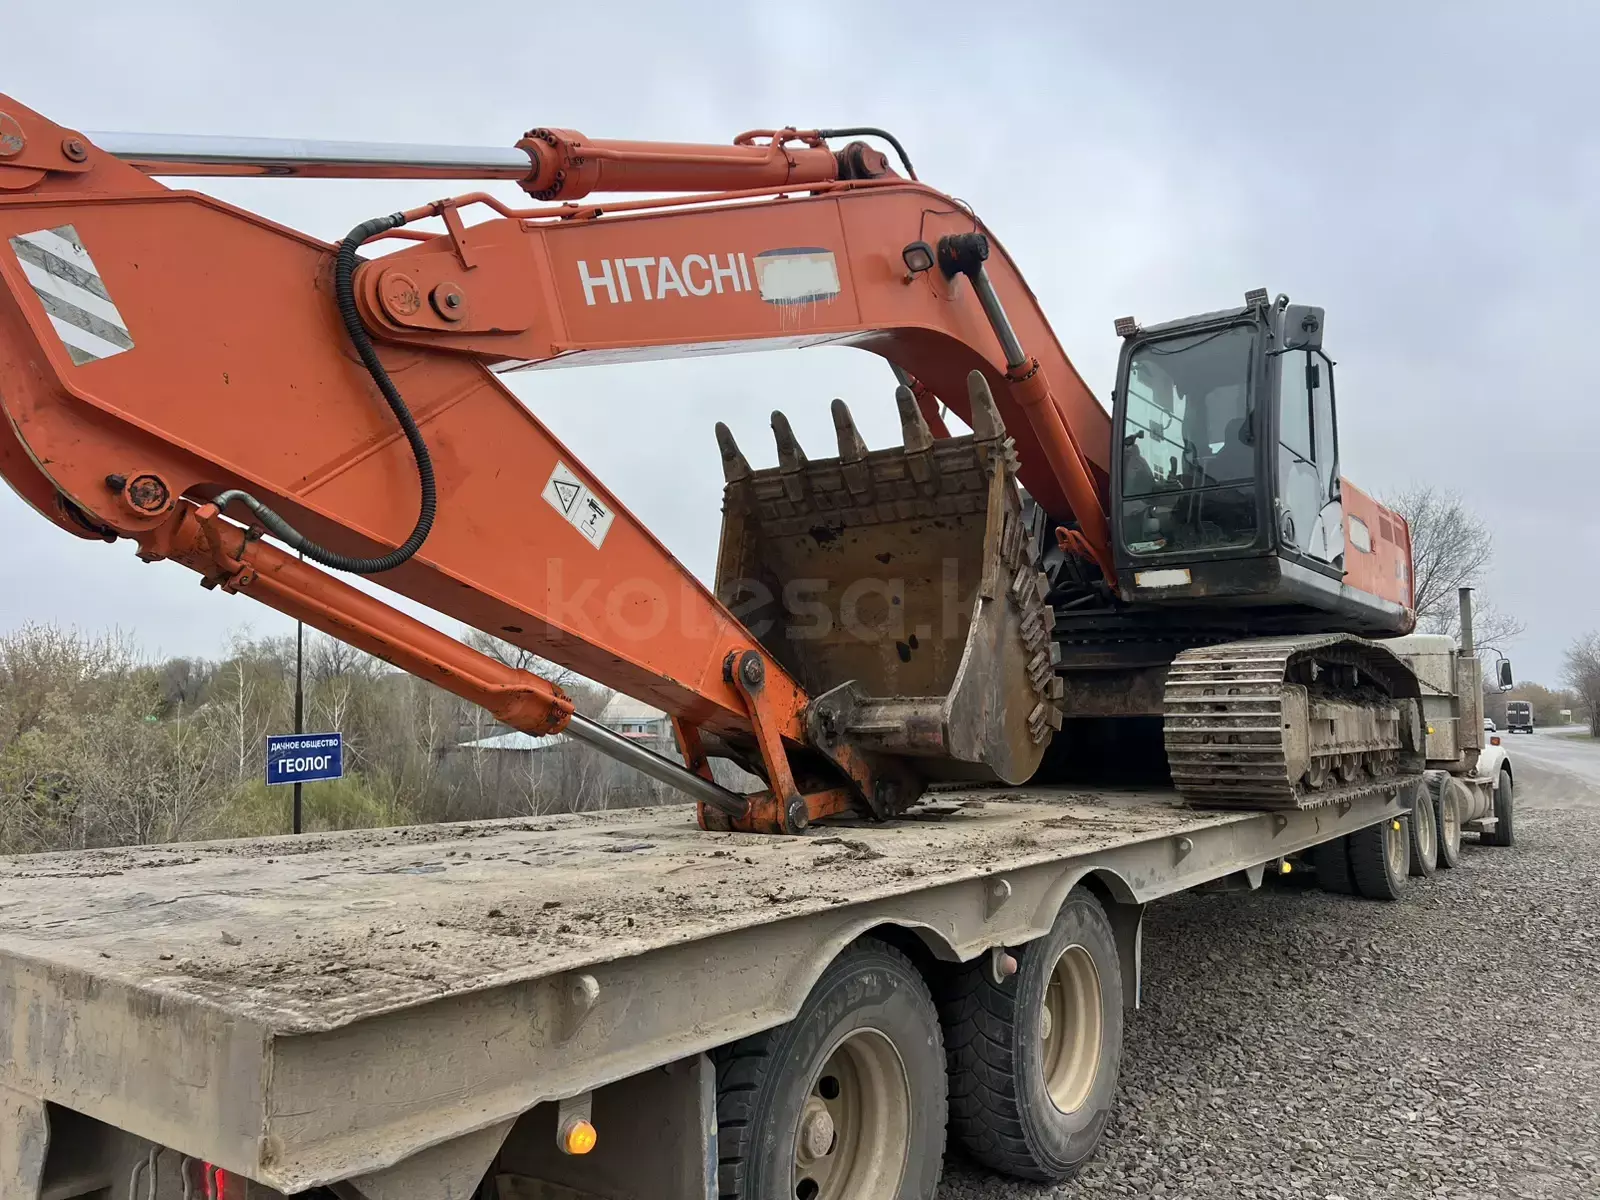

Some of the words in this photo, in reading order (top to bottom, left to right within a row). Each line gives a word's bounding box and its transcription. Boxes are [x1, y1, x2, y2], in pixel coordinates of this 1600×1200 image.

[577, 253, 752, 306] HITACHI
[271, 741, 300, 752] ДАЧНОЕ
[300, 739, 339, 749] ОБЩЕСТВО
[278, 755, 332, 774] ГЕОЛОГ
